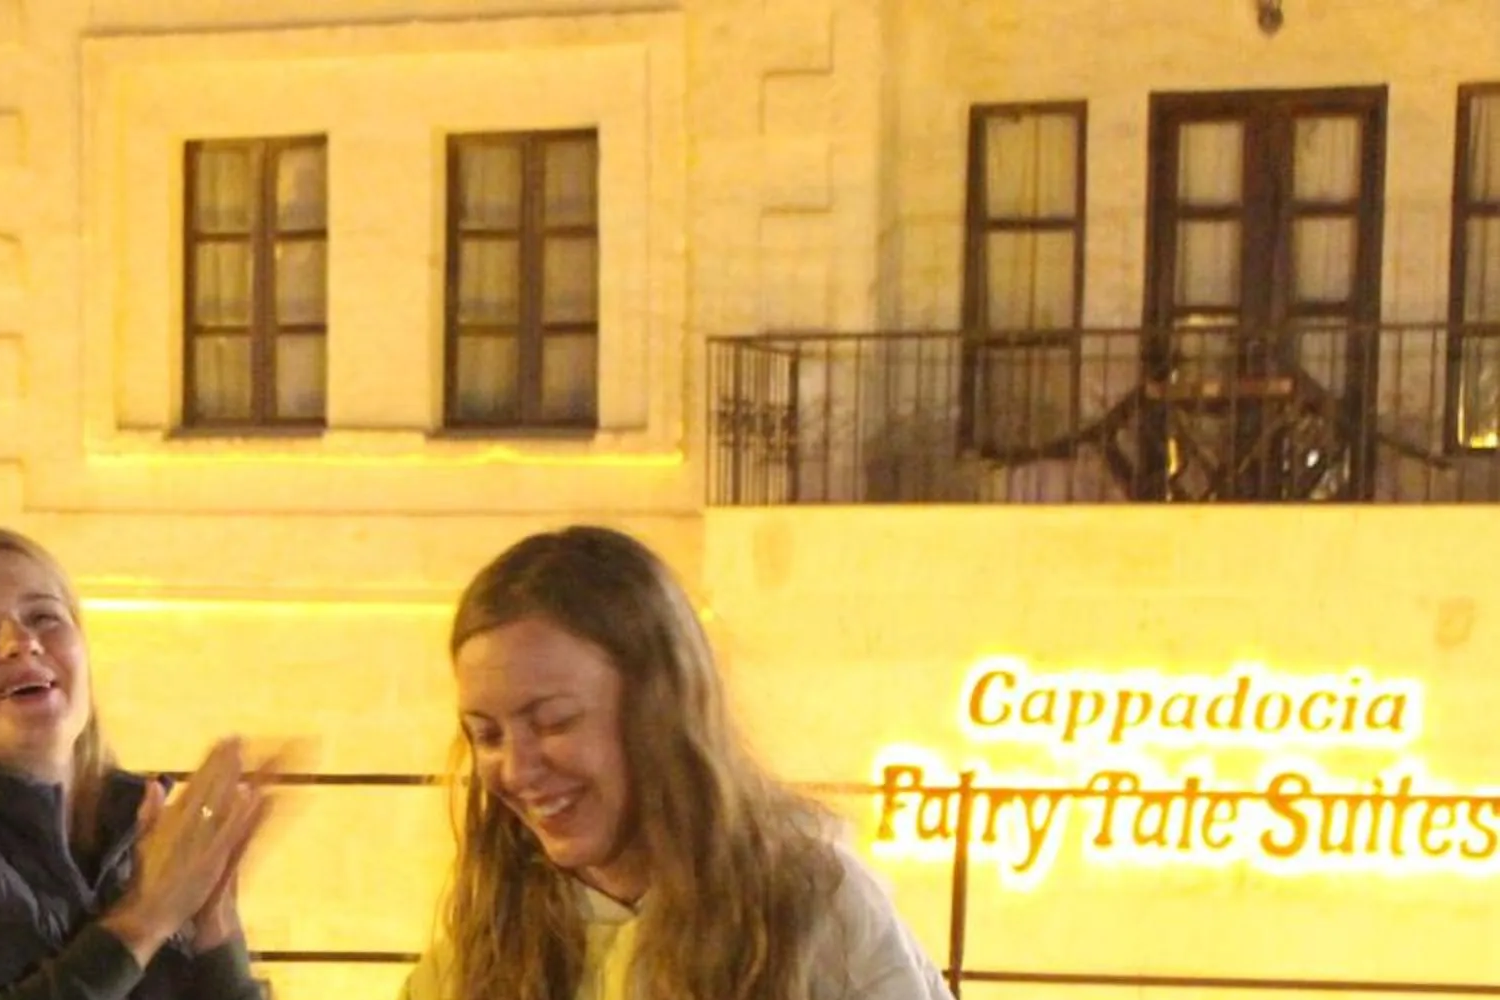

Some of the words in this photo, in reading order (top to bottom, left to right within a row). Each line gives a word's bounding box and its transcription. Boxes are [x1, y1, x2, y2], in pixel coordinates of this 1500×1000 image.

[968, 670, 1409, 744] Cappadocia
[1086, 770, 1238, 849] Tale
[1260, 772, 1500, 858] Suites
